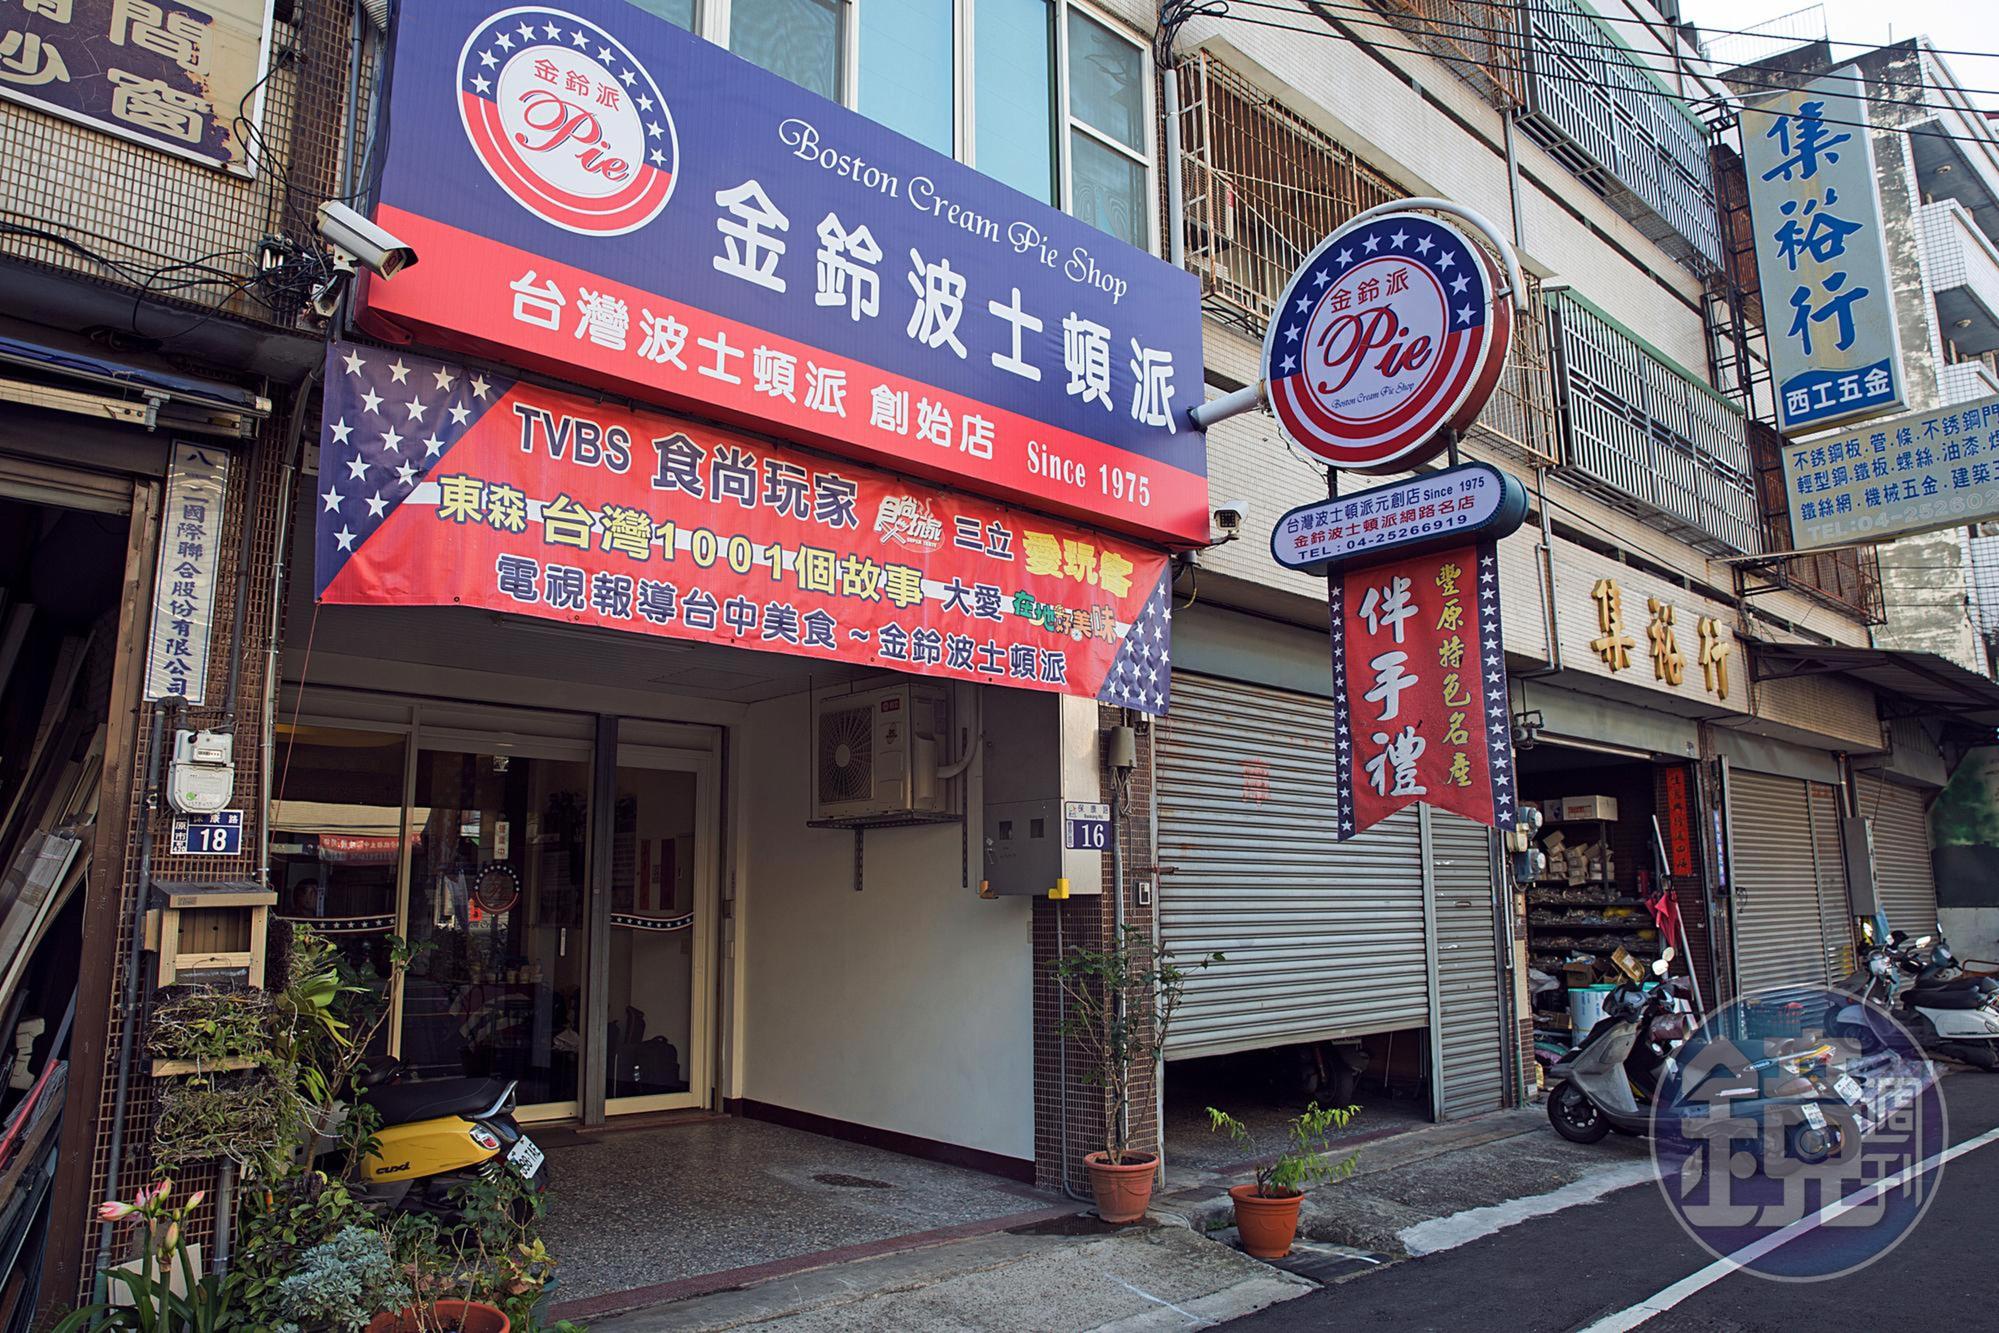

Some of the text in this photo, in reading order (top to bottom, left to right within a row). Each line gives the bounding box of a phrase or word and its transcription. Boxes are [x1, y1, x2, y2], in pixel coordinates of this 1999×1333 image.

[534, 59, 620, 111] 金鈴派
[515, 90, 629, 181] Pie
[779, 119, 1127, 304] Boston Cream Pie Shop
[1761, 101, 1870, 356] 集裕行
[712, 180, 1177, 435] 金鈴波士頓派
[1330, 267, 1411, 314] 金鈴派
[508, 269, 1151, 507] 台灣波士頓派 創始店 Since 1975
[1316, 303, 1433, 394] Pie
[1785, 366, 1892, 417] 西工五金
[1331, 397, 1356, 409] Boston
[1357, 392, 1379, 403] Cream
[1395, 381, 1415, 394] Shop
[513, 402, 632, 474] TVBS
[651, 432, 859, 531] 食尚玩家
[953, 515, 1014, 561] 三立
[1021, 530, 1135, 601] 愛玩客
[1286, 476, 1485, 534] 台灣波士頓派元創店 Since 1975
[1294, 495, 1476, 549] 金鈴波士頓派網路名店
[437, 473, 1119, 644] 東森 台灣1001個故事 大愛 在地好美味
[1358, 576, 1427, 797] 伴手禮
[1435, 563, 1472, 788] 豐原特色名產
[201, 828, 227, 851] 18
[1082, 824, 1104, 848] 16
